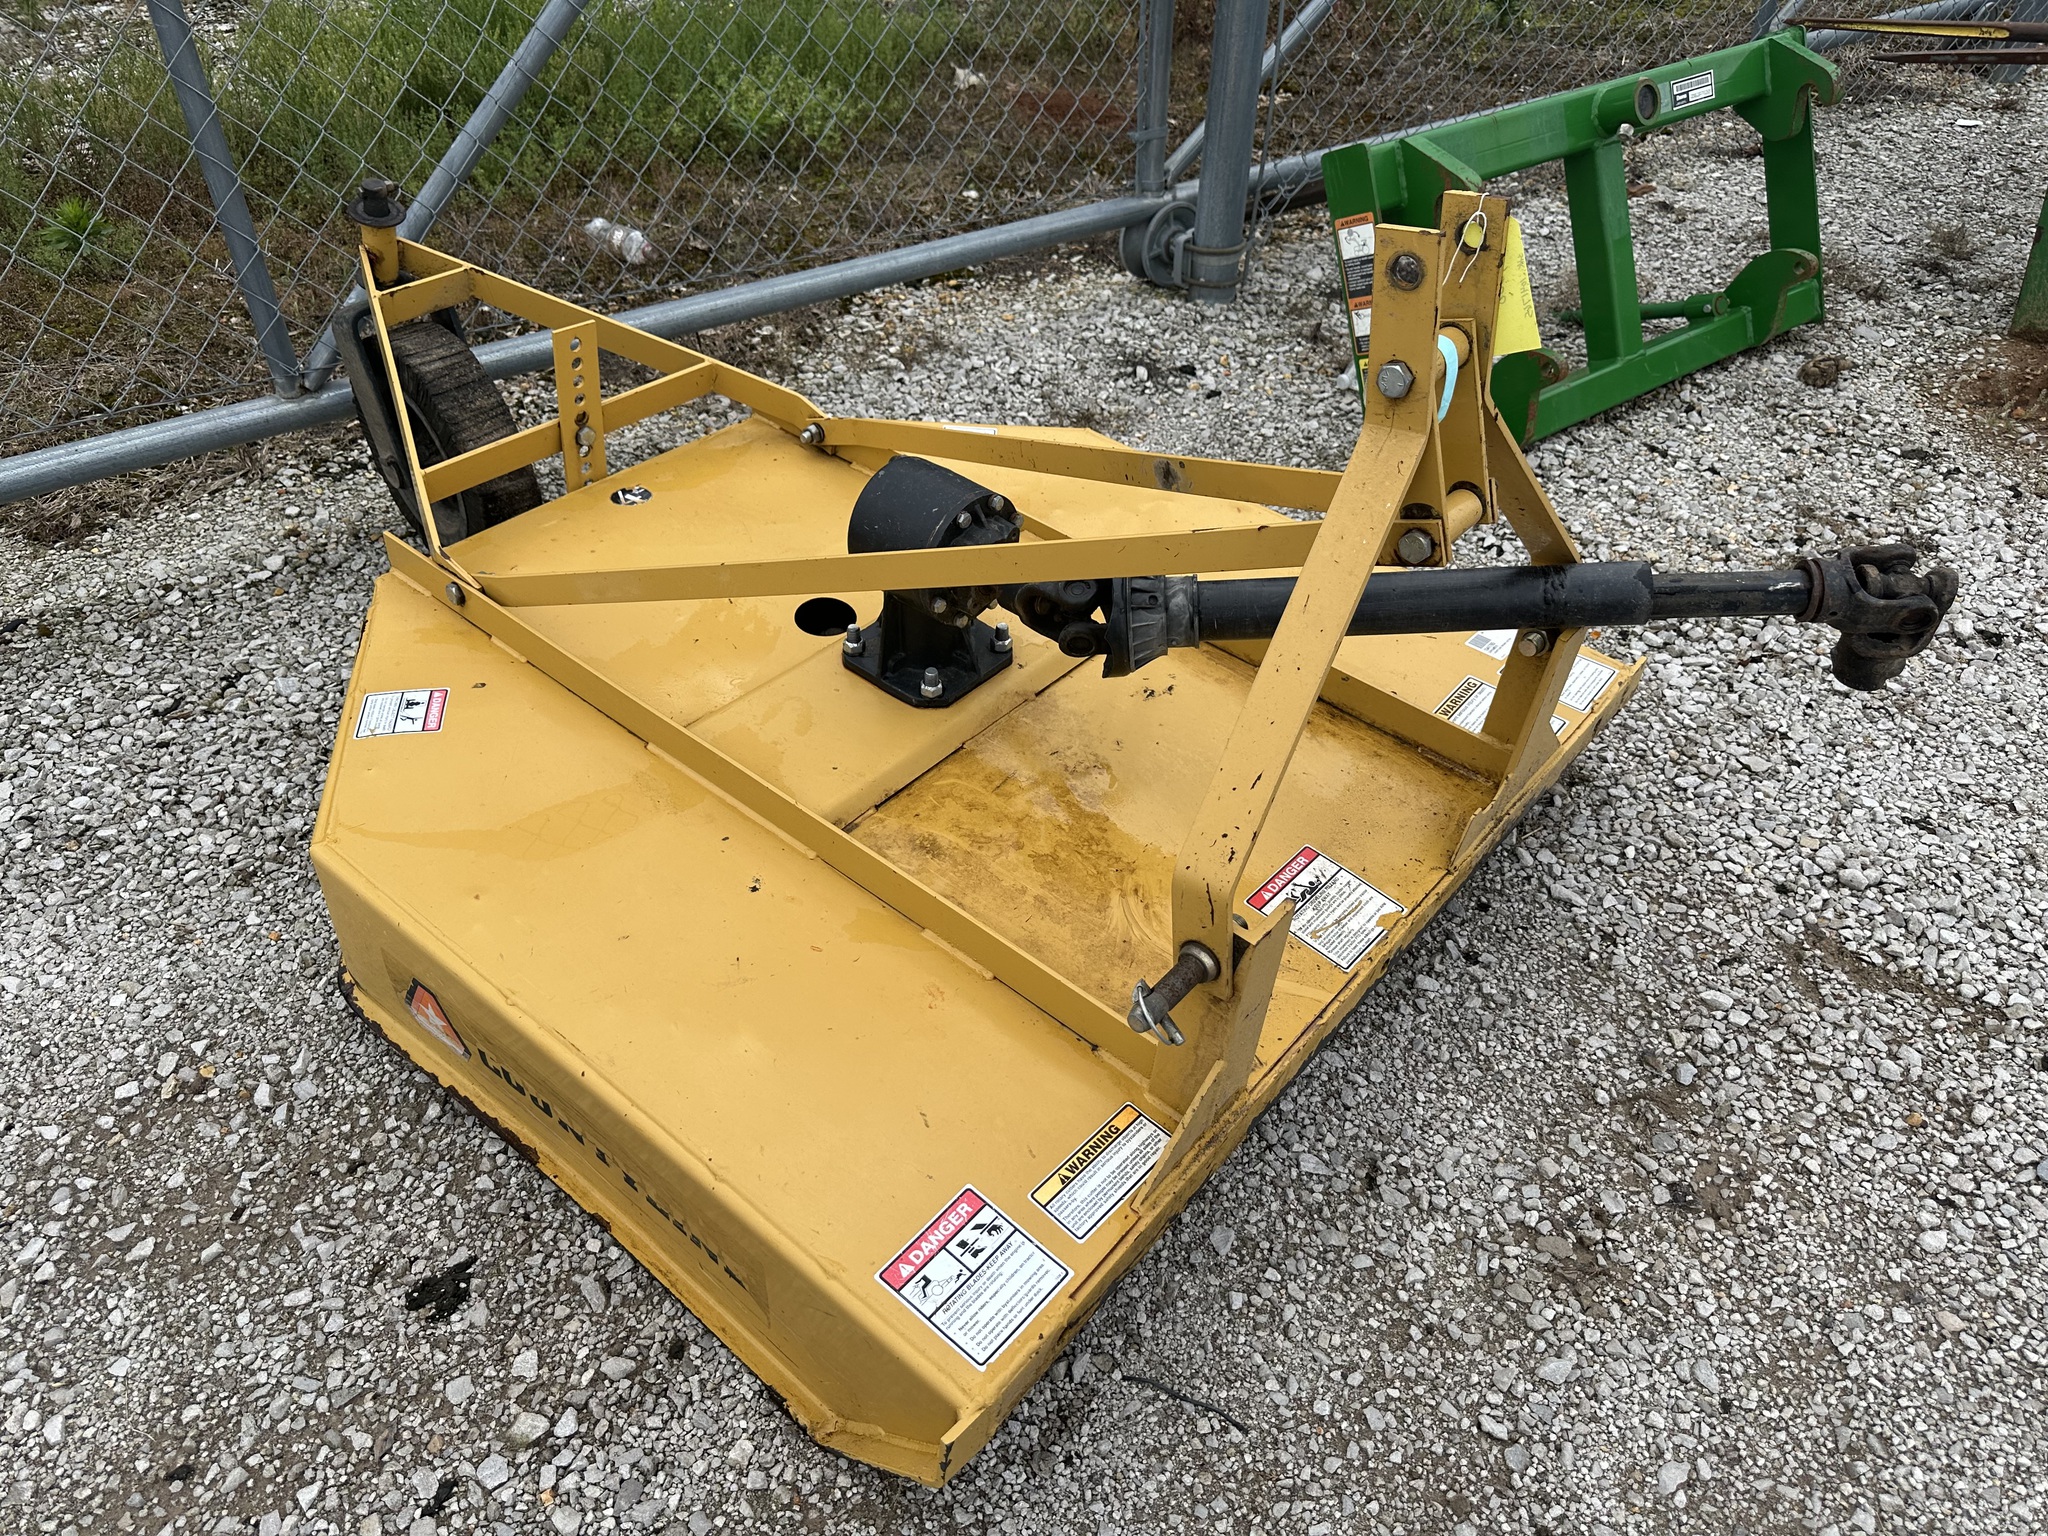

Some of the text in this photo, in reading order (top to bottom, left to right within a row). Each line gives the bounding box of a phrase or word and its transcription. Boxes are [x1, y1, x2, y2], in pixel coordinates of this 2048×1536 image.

[1344, 215, 1369, 226] WARNING
[1358, 300, 1372, 308] WARN
[427, 696, 442, 728] DANGER
[1438, 680, 1477, 717] WARNING
[1266, 855, 1309, 892] DANGER
[1064, 1123, 1121, 1175] WARNING
[907, 1201, 973, 1265] DANGER
[941, 1241, 1013, 1314] ROTATING BLADES-KEEP AWAY
